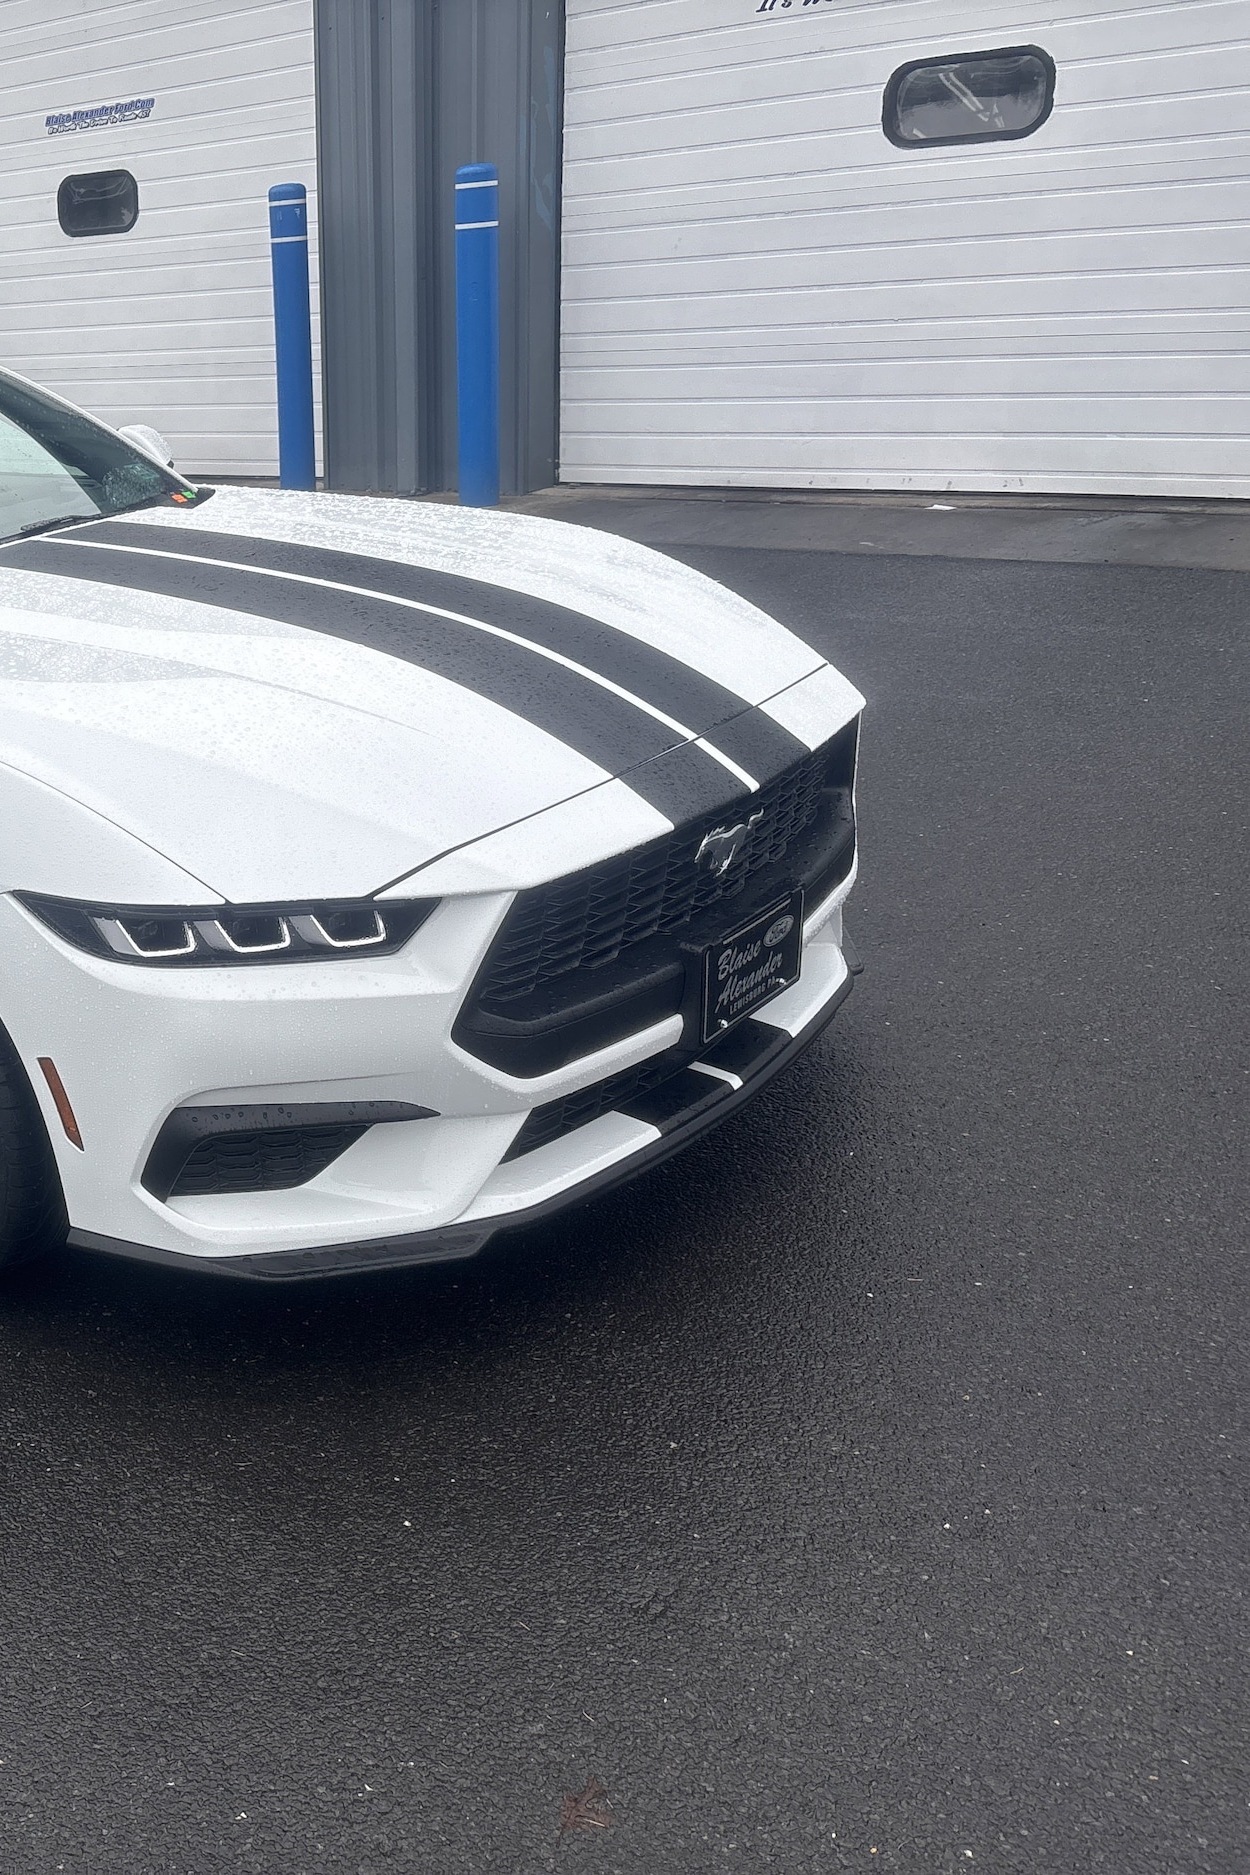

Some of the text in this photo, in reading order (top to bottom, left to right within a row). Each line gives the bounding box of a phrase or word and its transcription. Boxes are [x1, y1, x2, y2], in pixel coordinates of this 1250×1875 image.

[755, 0, 792, 13] Its
[718, 940, 761, 981] Blaise
[715, 951, 783, 1013] Alexander
[730, 976, 776, 1015] LEWISBURG PA
